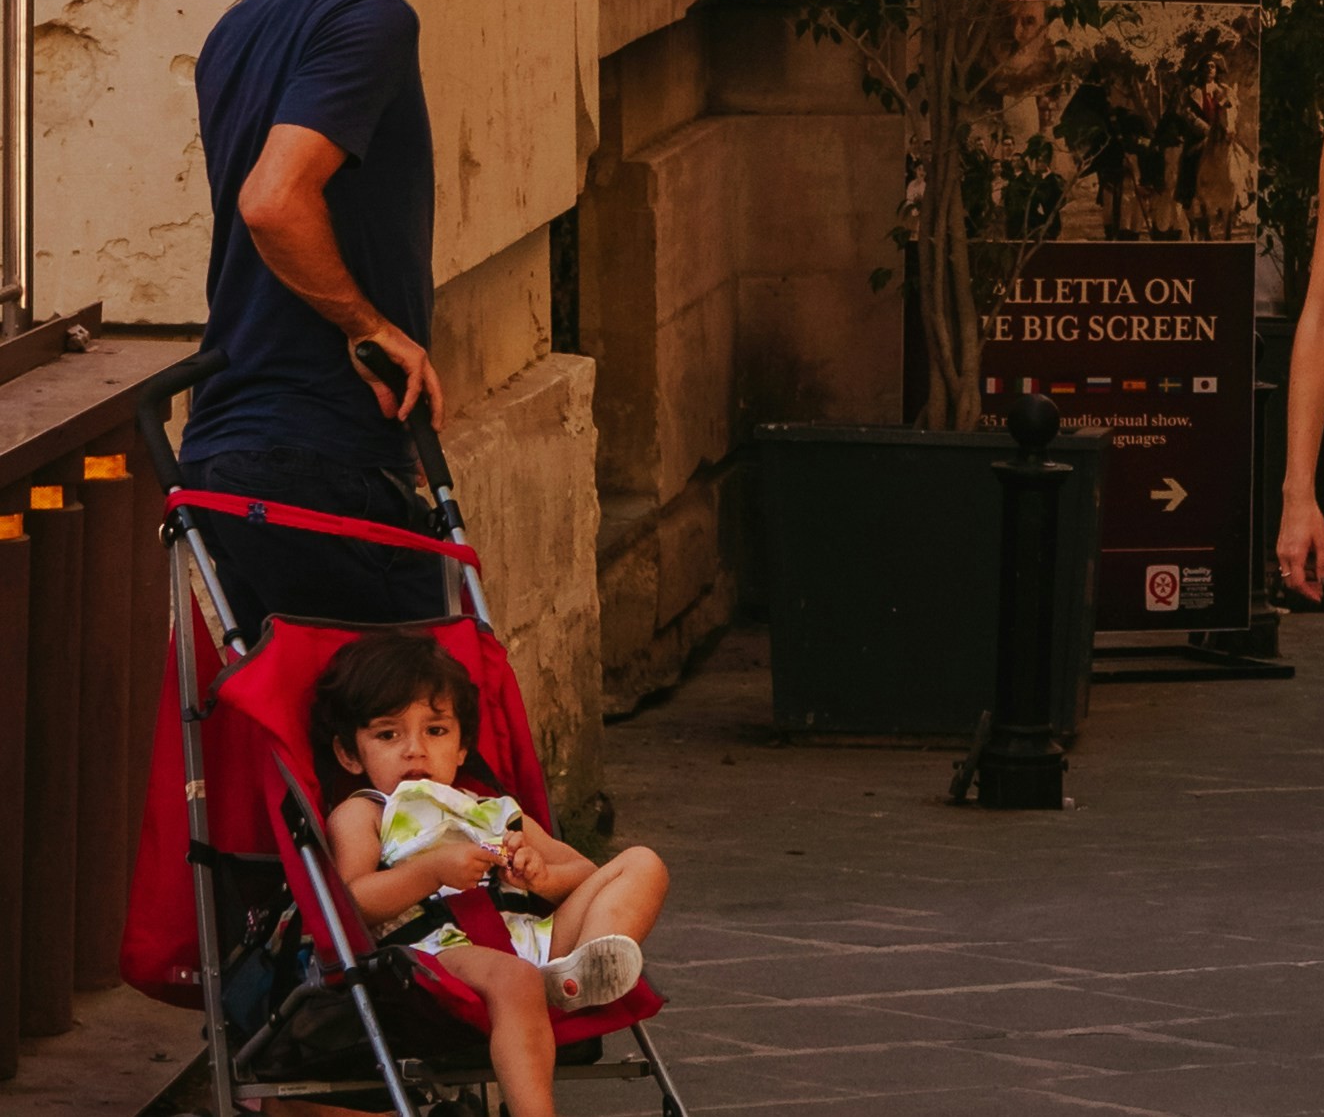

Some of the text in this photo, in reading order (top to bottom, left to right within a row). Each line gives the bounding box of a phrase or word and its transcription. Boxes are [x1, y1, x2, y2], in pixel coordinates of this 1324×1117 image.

[986, 277, 1196, 305] LLETTA ON
[1022, 315, 1080, 342] BIG
[1088, 314, 1218, 342] SCREEN
[1059, 413, 1101, 428] audio
[1104, 413, 1148, 427] visual
[1113, 434, 1167, 449] guages
